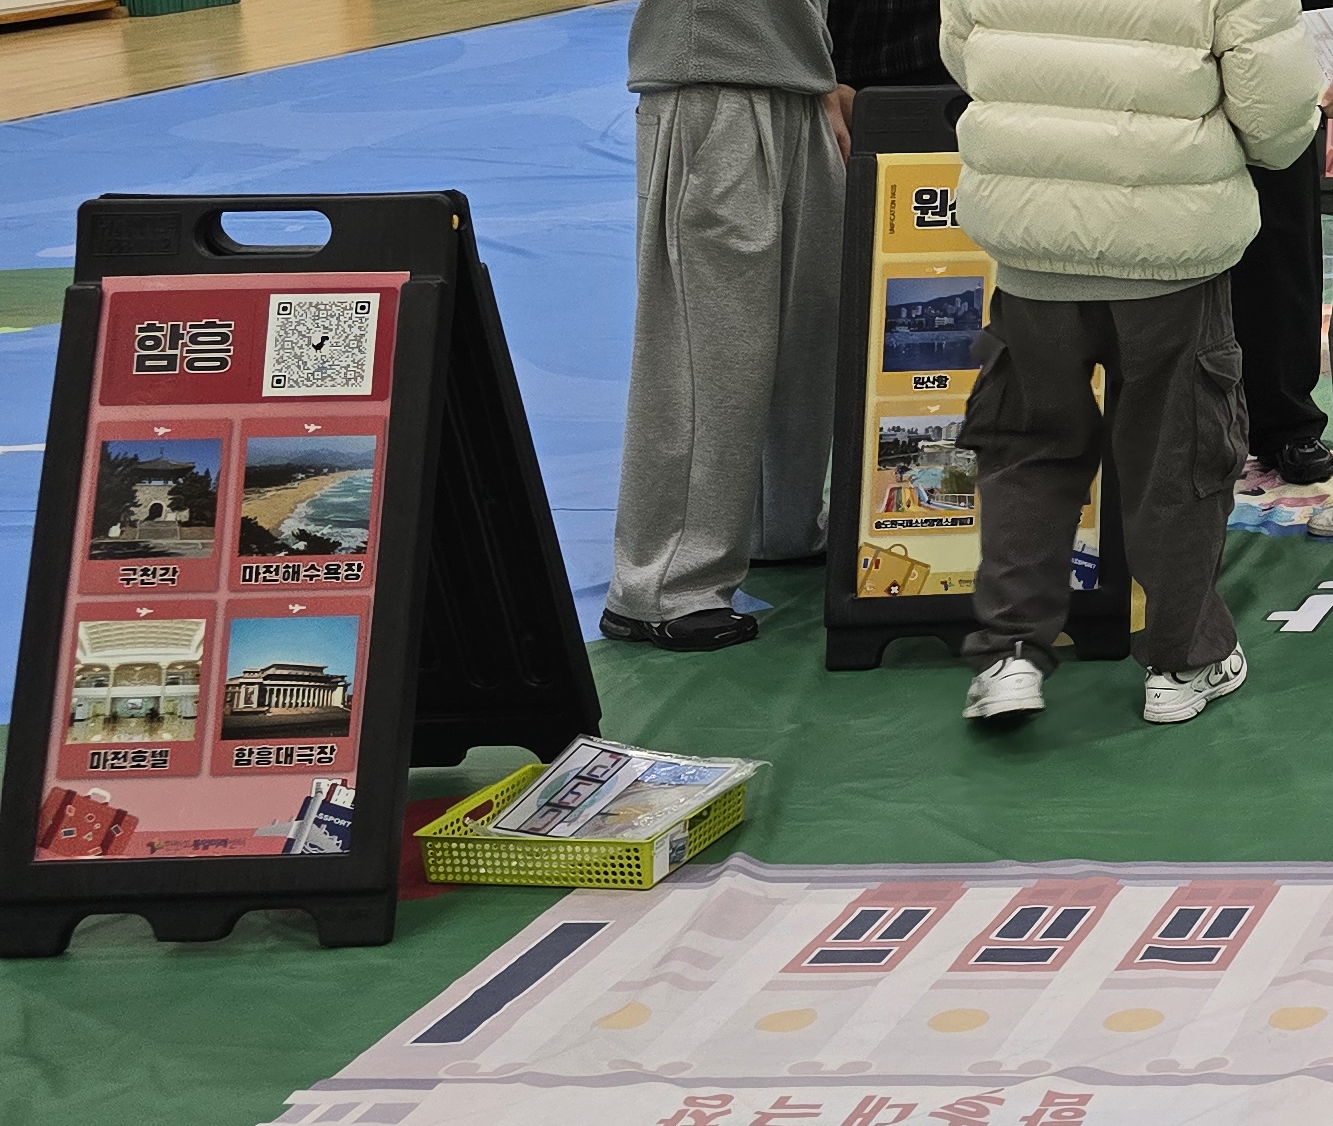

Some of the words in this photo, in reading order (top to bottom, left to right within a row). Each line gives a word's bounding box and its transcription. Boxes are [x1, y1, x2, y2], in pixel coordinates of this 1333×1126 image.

[131, 317, 236, 376] 함흥
[118, 564, 180, 587] 구천각
[239, 561, 365, 586] 마전해수욕장
[86, 748, 171, 772] 마전호텔
[230, 743, 338, 769] 함흥대극장
